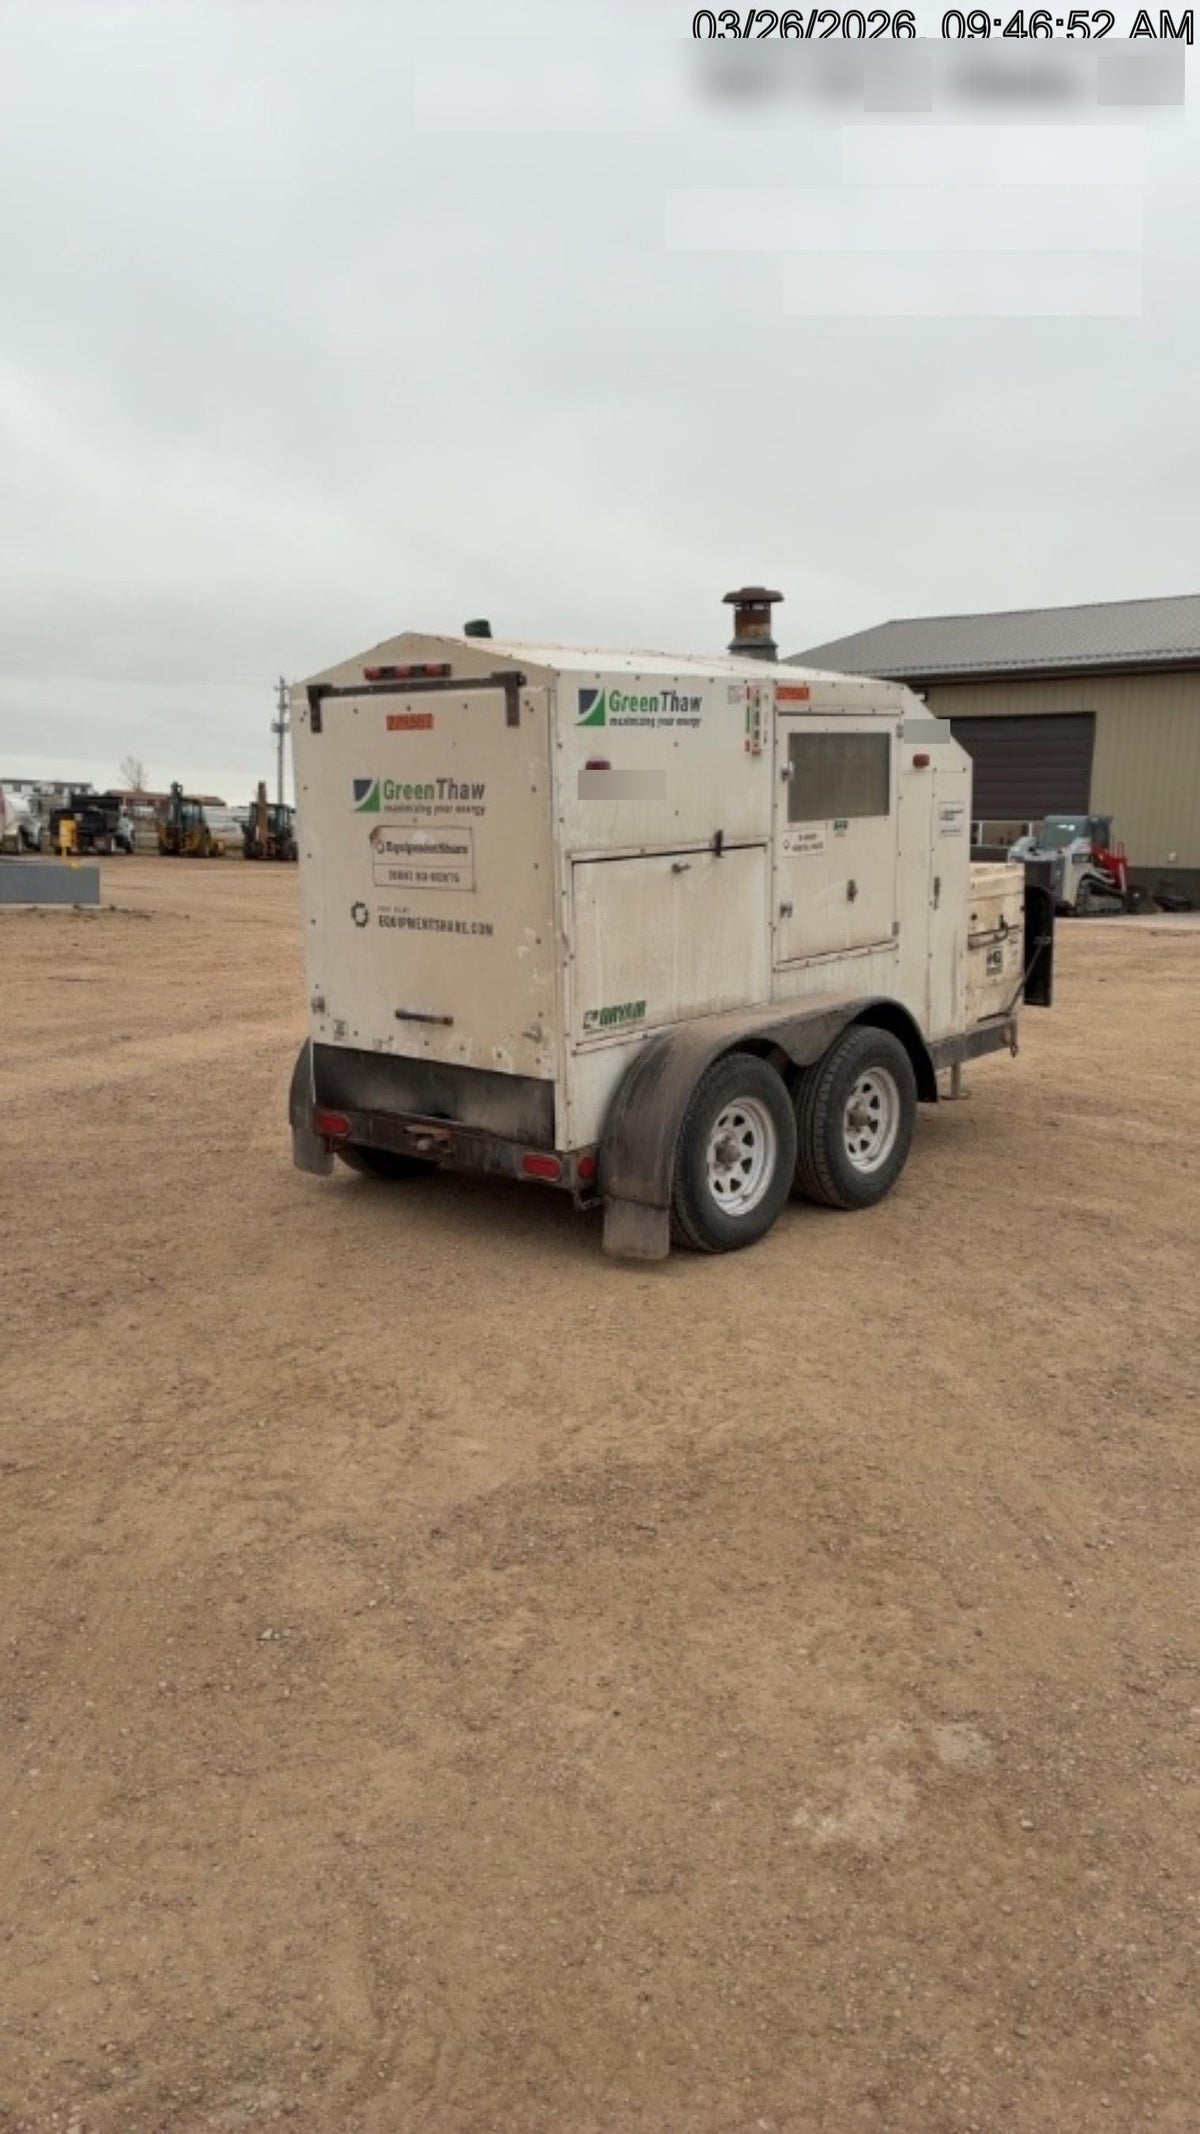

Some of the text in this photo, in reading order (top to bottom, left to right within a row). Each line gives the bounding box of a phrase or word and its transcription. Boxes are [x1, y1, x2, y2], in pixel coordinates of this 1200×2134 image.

[609, 689, 702, 713] GreenThaw
[383, 777, 485, 801] GreenThaw
[383, 804, 432, 816] maximizing
